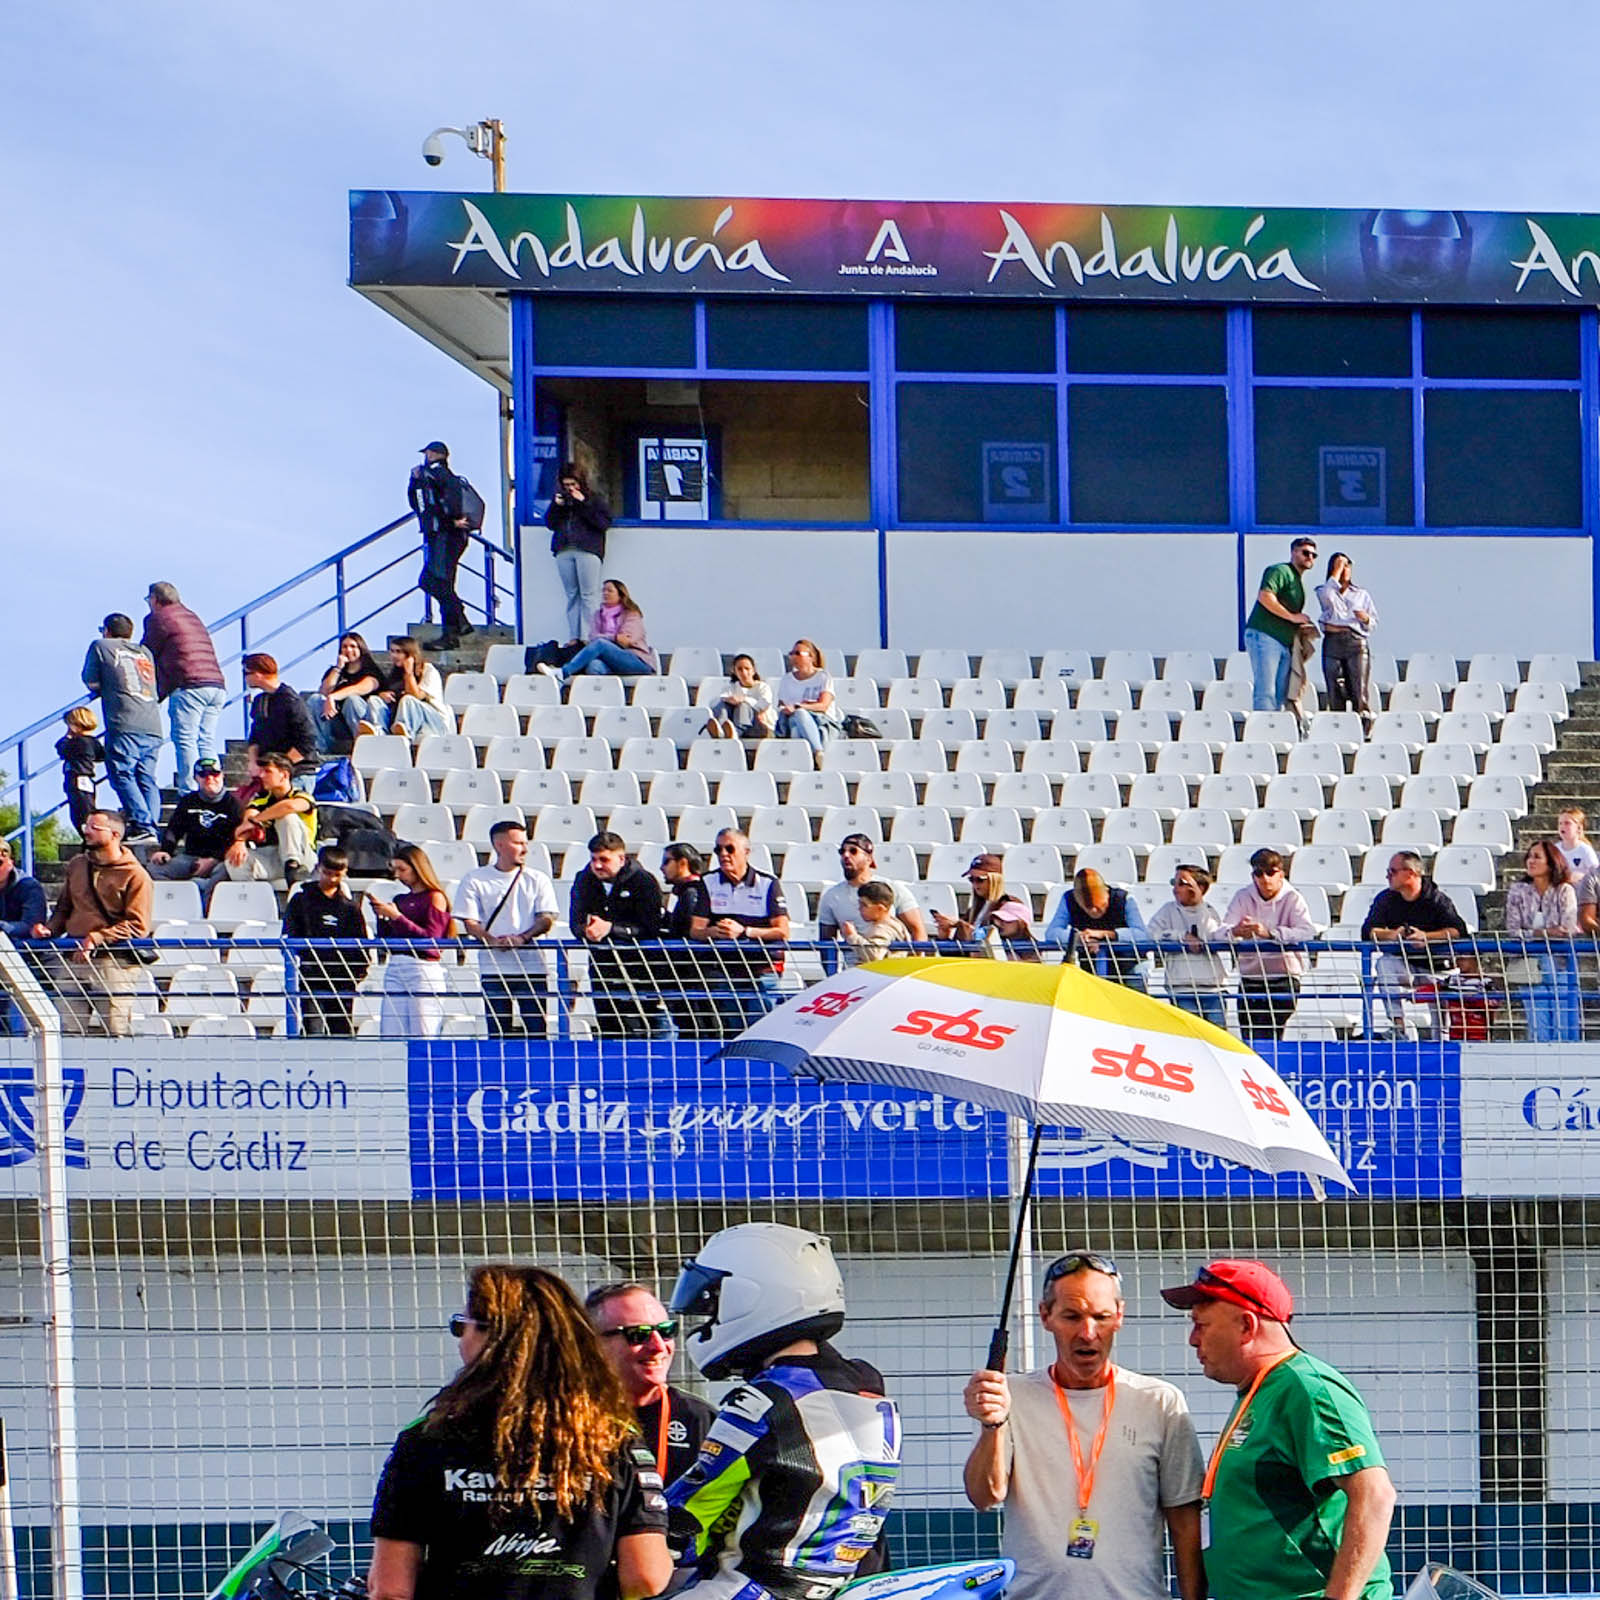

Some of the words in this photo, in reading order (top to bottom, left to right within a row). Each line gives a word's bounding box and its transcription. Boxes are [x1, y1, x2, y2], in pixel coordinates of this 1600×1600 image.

[447, 199, 791, 282] Andalucía
[983, 209, 1321, 291] Andalucía
[839, 264, 869, 277] Junta
[871, 264, 884, 275] de
[892, 1007, 1017, 1051] sbs
[111, 1068, 347, 1112] Diputación
[1091, 1043, 1194, 1093] sbs
[1286, 1070, 1417, 1111] tación
[467, 1085, 629, 1134] Cádiz
[637, 1096, 830, 1158] quiere
[841, 1093, 984, 1132] verte
[114, 1131, 163, 1170] de
[188, 1128, 309, 1170] Cádiz
[484, 1533, 561, 1560] Ninja
